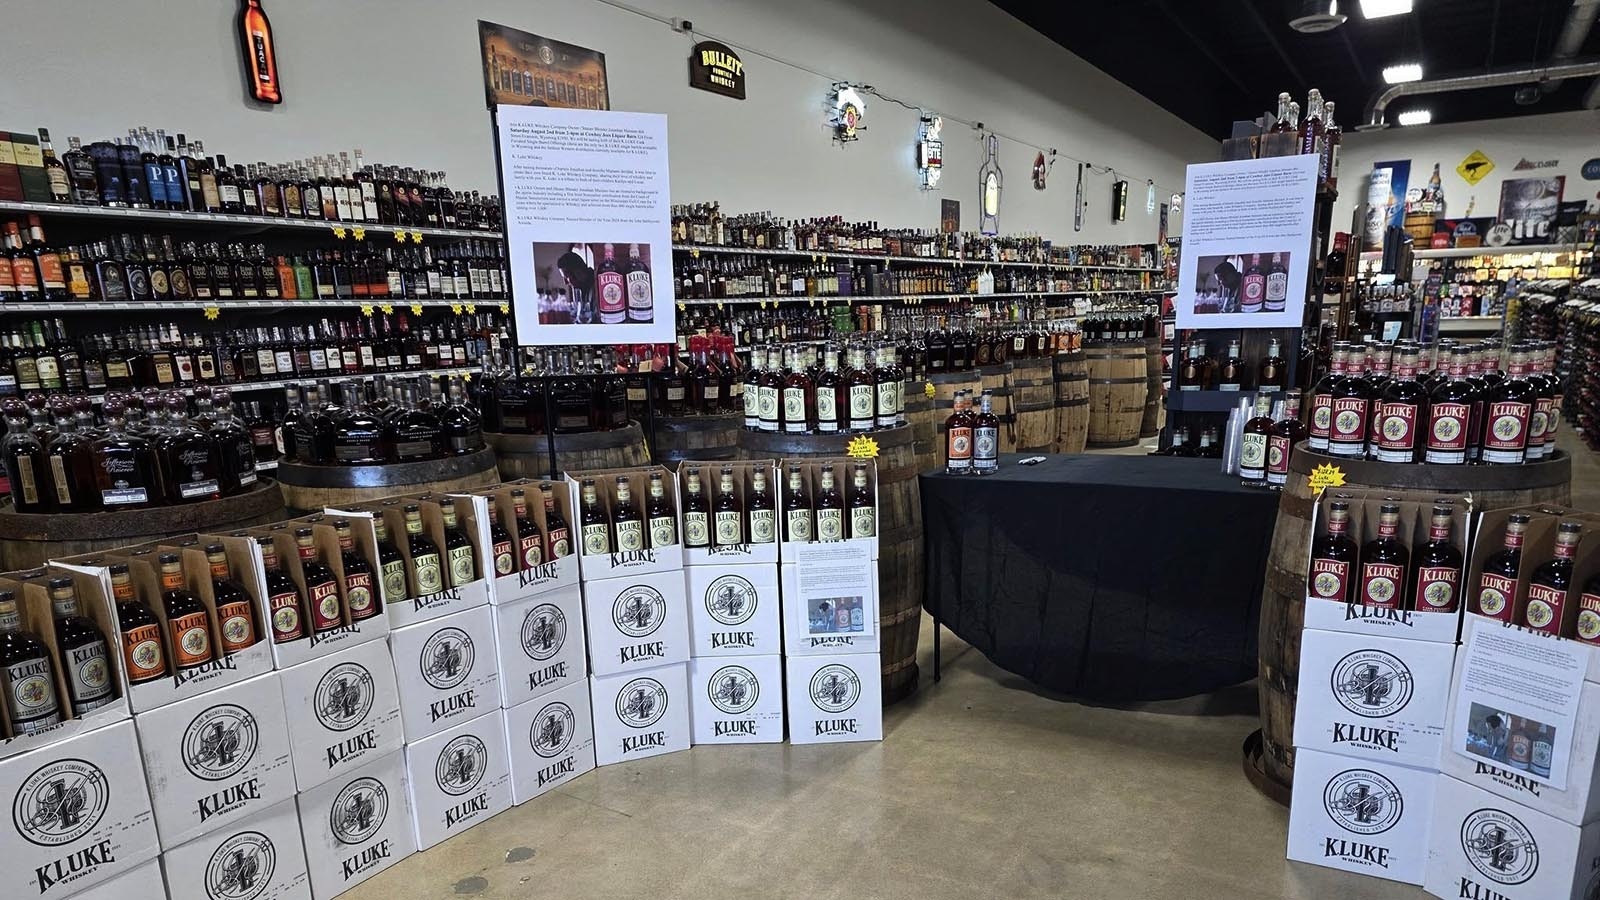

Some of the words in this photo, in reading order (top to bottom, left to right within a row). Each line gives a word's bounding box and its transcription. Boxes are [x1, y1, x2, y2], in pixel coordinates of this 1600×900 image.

[702, 50, 742, 76] BULLEIT
[710, 74, 735, 88] WHISKEY
[150, 166, 162, 180] P
[166, 168, 178, 182] P
[600, 275, 622, 286] KLUKE
[628, 272, 648, 282] KLUKE
[852, 386, 872, 396] KLUKE
[1335, 401, 1364, 412] KLUKE
[1382, 405, 1412, 418] KLUKE
[1433, 406, 1466, 419] KLUKE
[1492, 405, 1526, 418] KLUKE
[684, 513, 706, 522] KLUKE
[718, 513, 739, 522] KLUKE
[752, 511, 774, 520] KLUKE
[791, 510, 810, 520] KLUKE
[820, 510, 840, 520] KLUKE
[854, 508, 874, 518] KLUKE
[618, 522, 641, 532] KLUKE
[652, 518, 674, 528] KLUKE
[584, 525, 606, 535] KLUKE
[1314, 562, 1344, 576] KLUKE
[1366, 566, 1400, 580] KLUKE
[348, 576, 370, 588] LUKE
[1424, 570, 1457, 582] KLUKE
[217, 604, 249, 620] KLUKE
[1364, 618, 1397, 627] WHISKEY
[126, 625, 160, 646] KLUKE
[8, 659, 48, 683] KLUKE
[192, 671, 222, 684] WHISKEY
[27, 722, 66, 738] WHISKEY
[1350, 742, 1382, 751] WHISKEY
[1492, 776, 1524, 792] WHISKEY
[217, 801, 248, 816] WHISKEY
[1342, 856, 1372, 866] WHISKEY
[61, 866, 98, 884] WHISKEY
